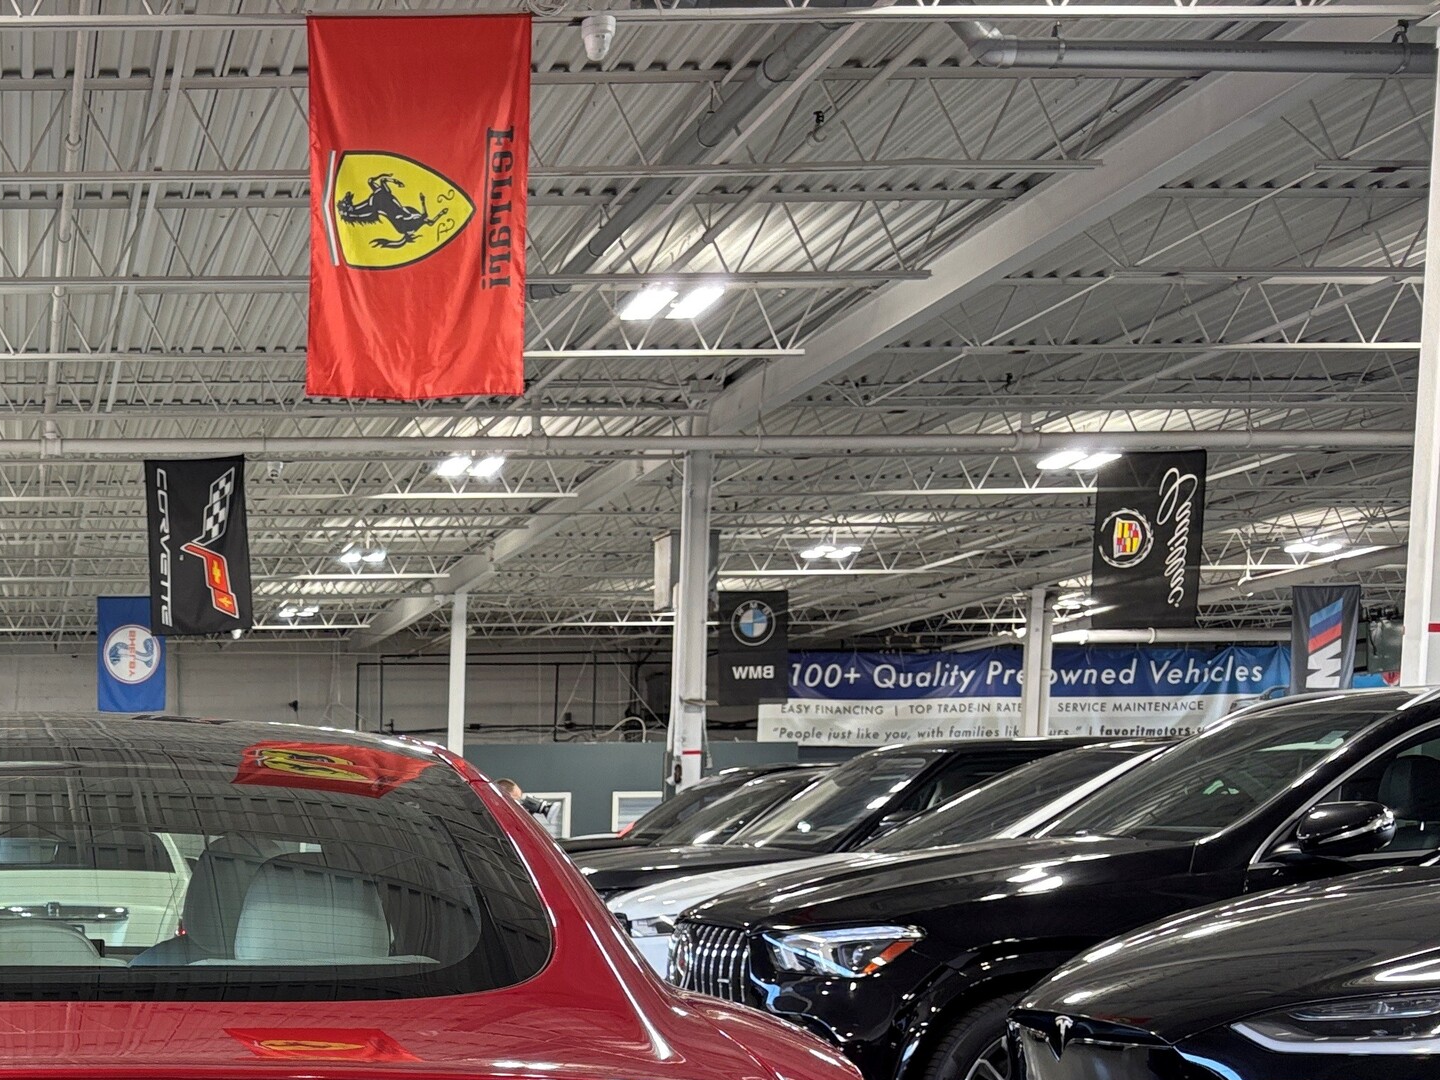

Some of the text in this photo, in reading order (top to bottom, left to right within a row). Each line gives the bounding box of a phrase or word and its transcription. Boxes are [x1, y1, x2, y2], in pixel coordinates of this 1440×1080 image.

[157, 468, 173, 628] CORVETTE
[791, 663, 860, 688] 100+
[873, 661, 976, 693] Quality
[1149, 656, 1262, 684] Vehicles
[780, 700, 1204, 716] EASY FINANCING TOP TRADE-IN RATE SERVICE MAINTENANCE
[828, 727, 852, 740] just
[857, 727, 880, 740] like
[917, 727, 944, 739] with
[949, 725, 1000, 738] families
[1005, 725, 1020, 737] lik
